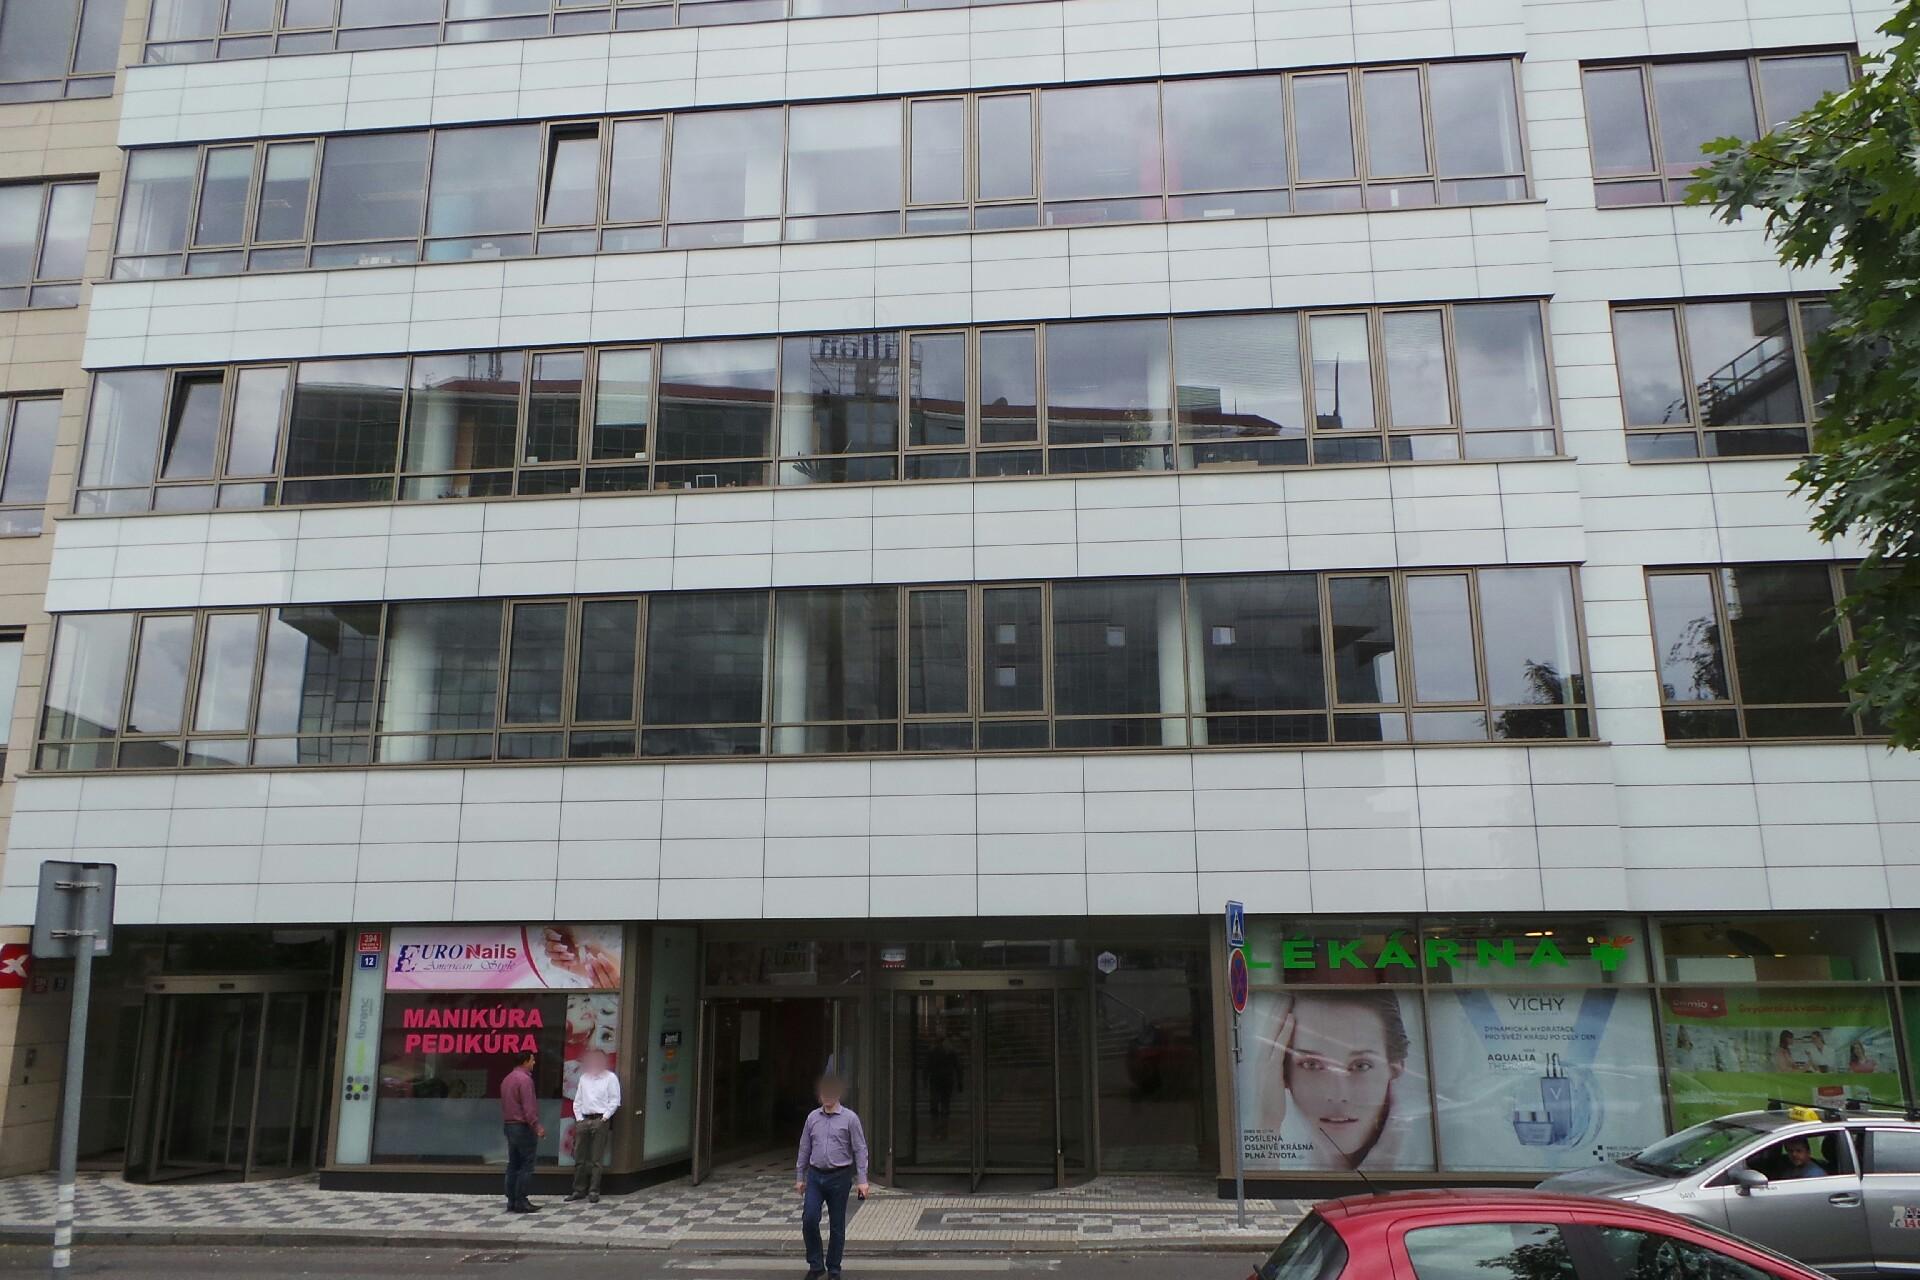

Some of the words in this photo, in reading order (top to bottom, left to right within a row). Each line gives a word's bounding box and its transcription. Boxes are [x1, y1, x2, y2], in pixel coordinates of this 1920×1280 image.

[395, 944, 463, 973] EURO
[465, 944, 517, 959] Nails
[1243, 931, 1568, 969] LÉKÁRNA
[365, 957, 374, 966] 12
[423, 961, 473, 970] American
[480, 960, 516, 973] Style
[1508, 998, 1565, 1011] VICHY
[403, 1004, 544, 1028] MANIKÚRA
[405, 1030, 538, 1053] PEDIKÚRA
[1487, 1053, 1536, 1061] AQUALIA
